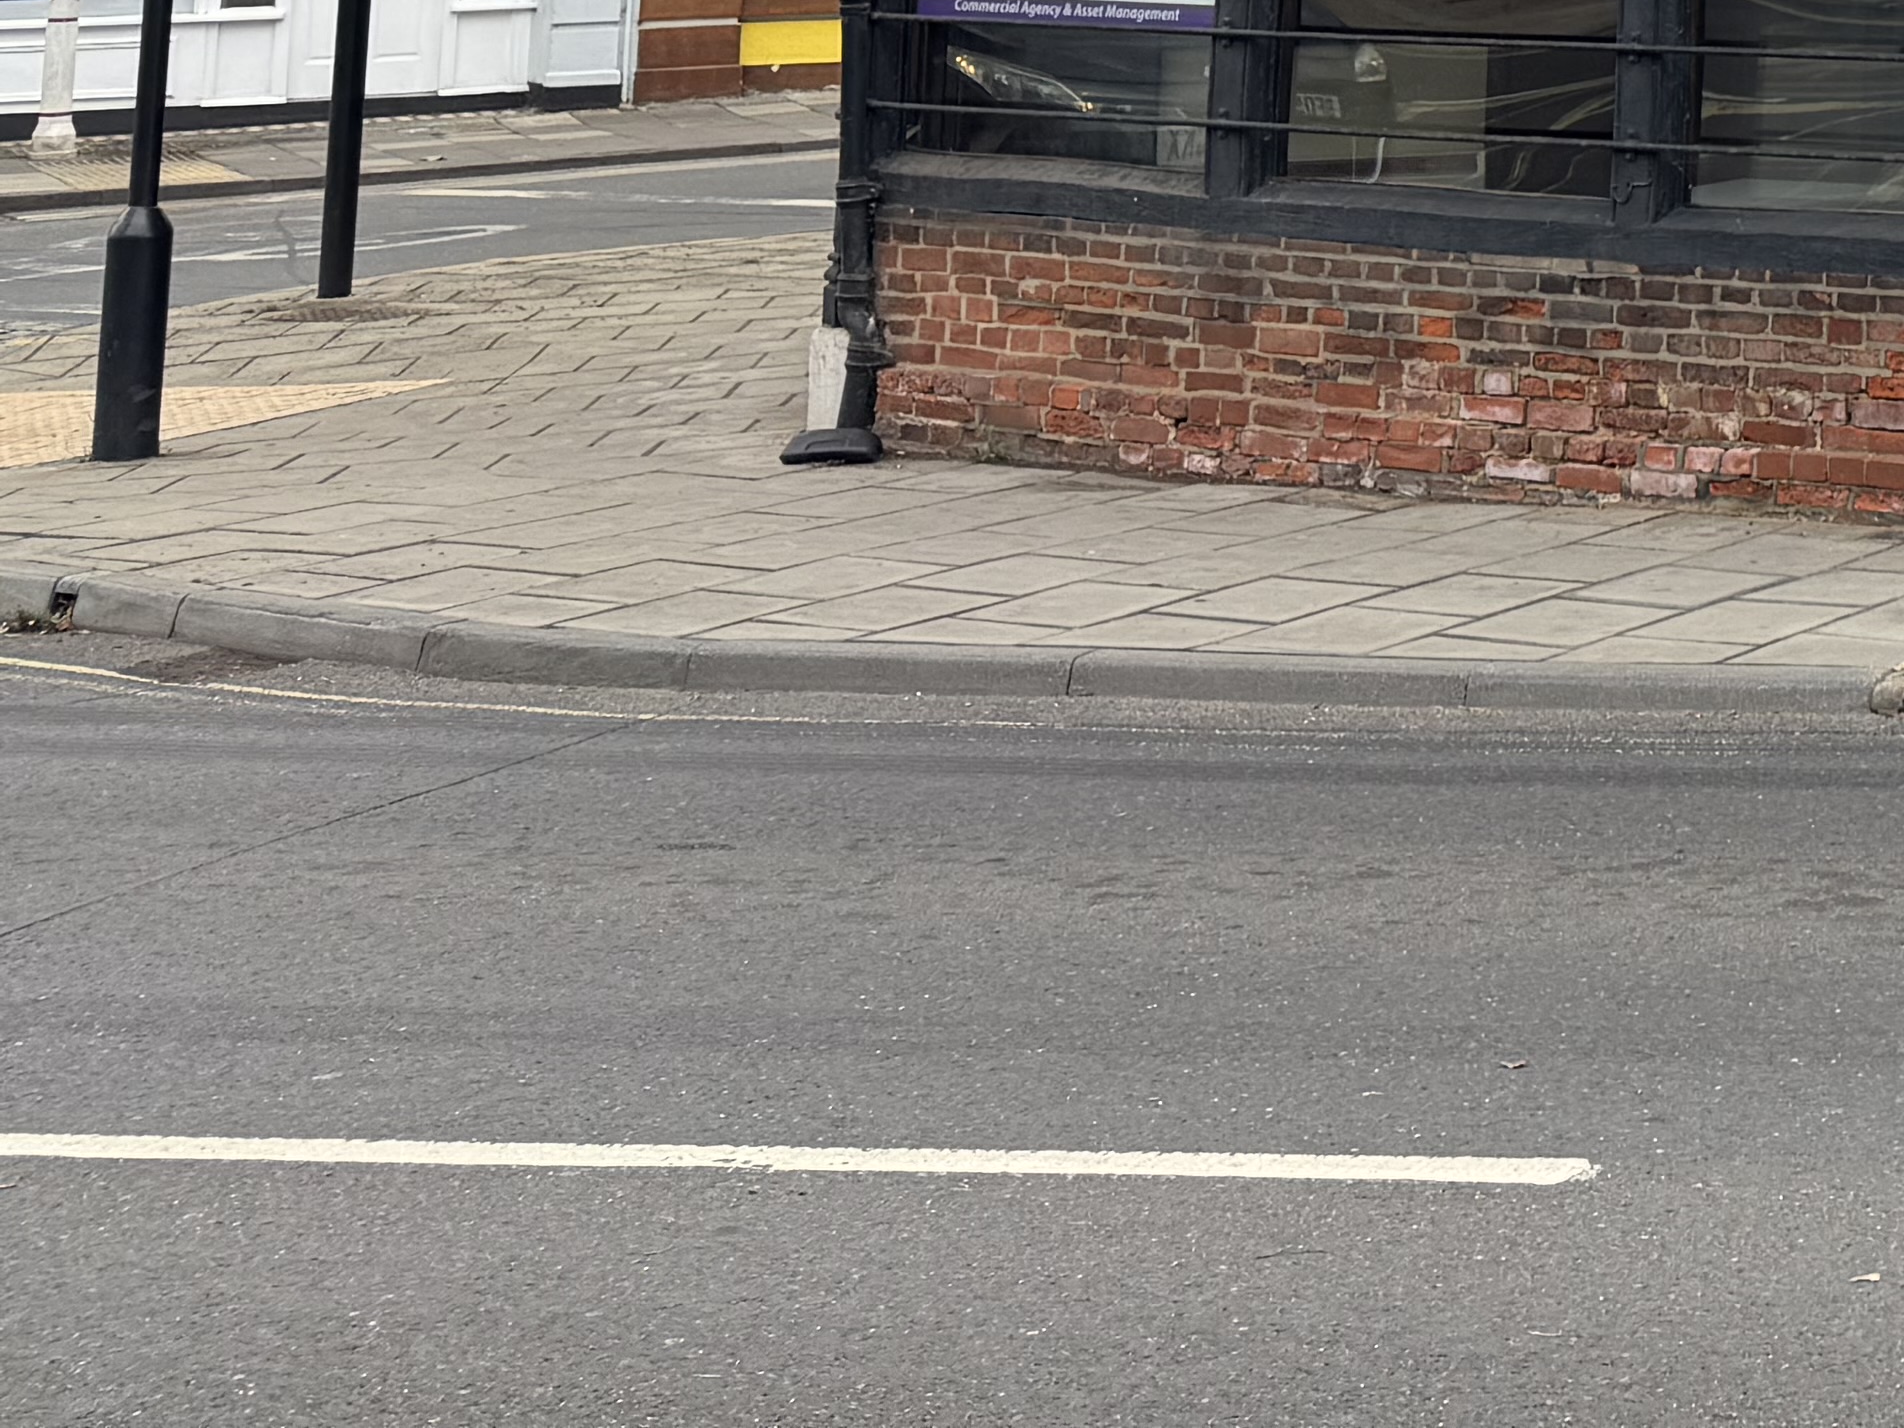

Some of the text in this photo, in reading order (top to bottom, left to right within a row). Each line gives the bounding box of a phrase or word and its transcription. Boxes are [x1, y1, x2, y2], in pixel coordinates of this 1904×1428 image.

[1021, 1, 1062, 19] Agency
[1062, 2, 1073, 17] &
[1073, 3, 1103, 18] Asset
[1104, 4, 1180, 23] Management
